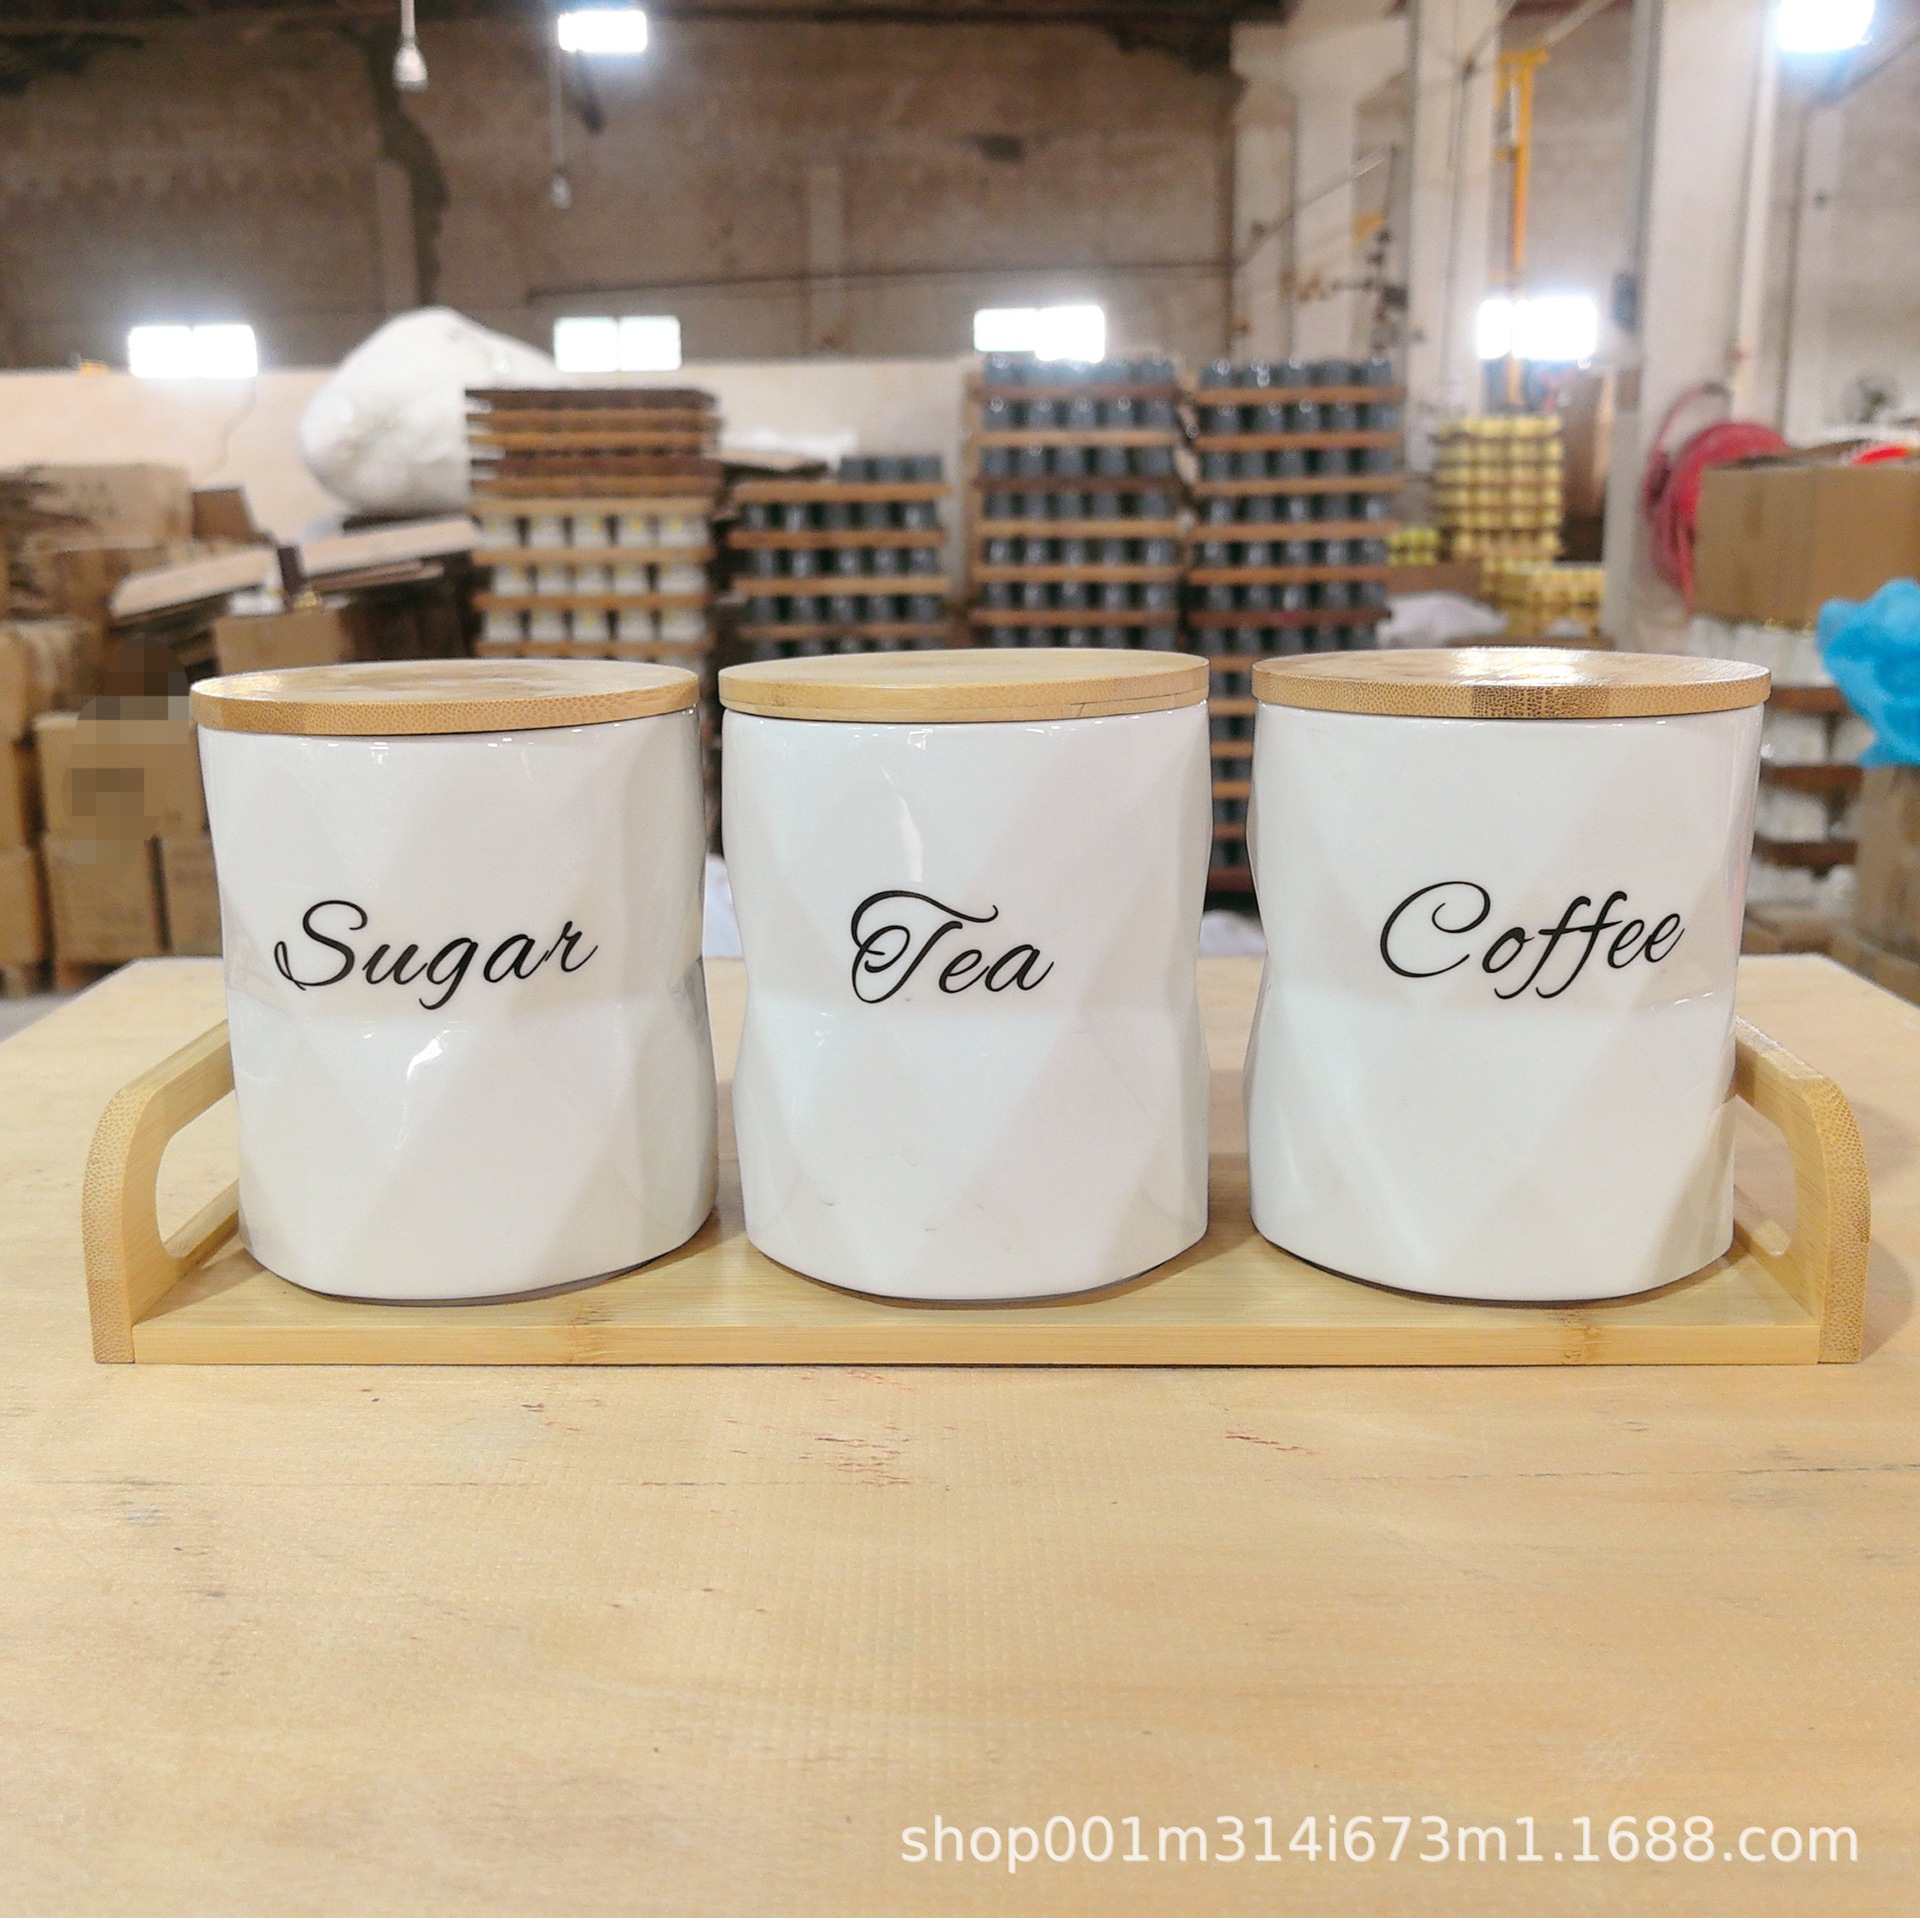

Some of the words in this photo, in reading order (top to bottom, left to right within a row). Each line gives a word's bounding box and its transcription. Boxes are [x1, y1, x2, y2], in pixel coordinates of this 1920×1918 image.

[274, 900, 599, 1011] Sugar
[851, 889, 1054, 1004] Tea
[1380, 880, 1685, 1000] Coffee
